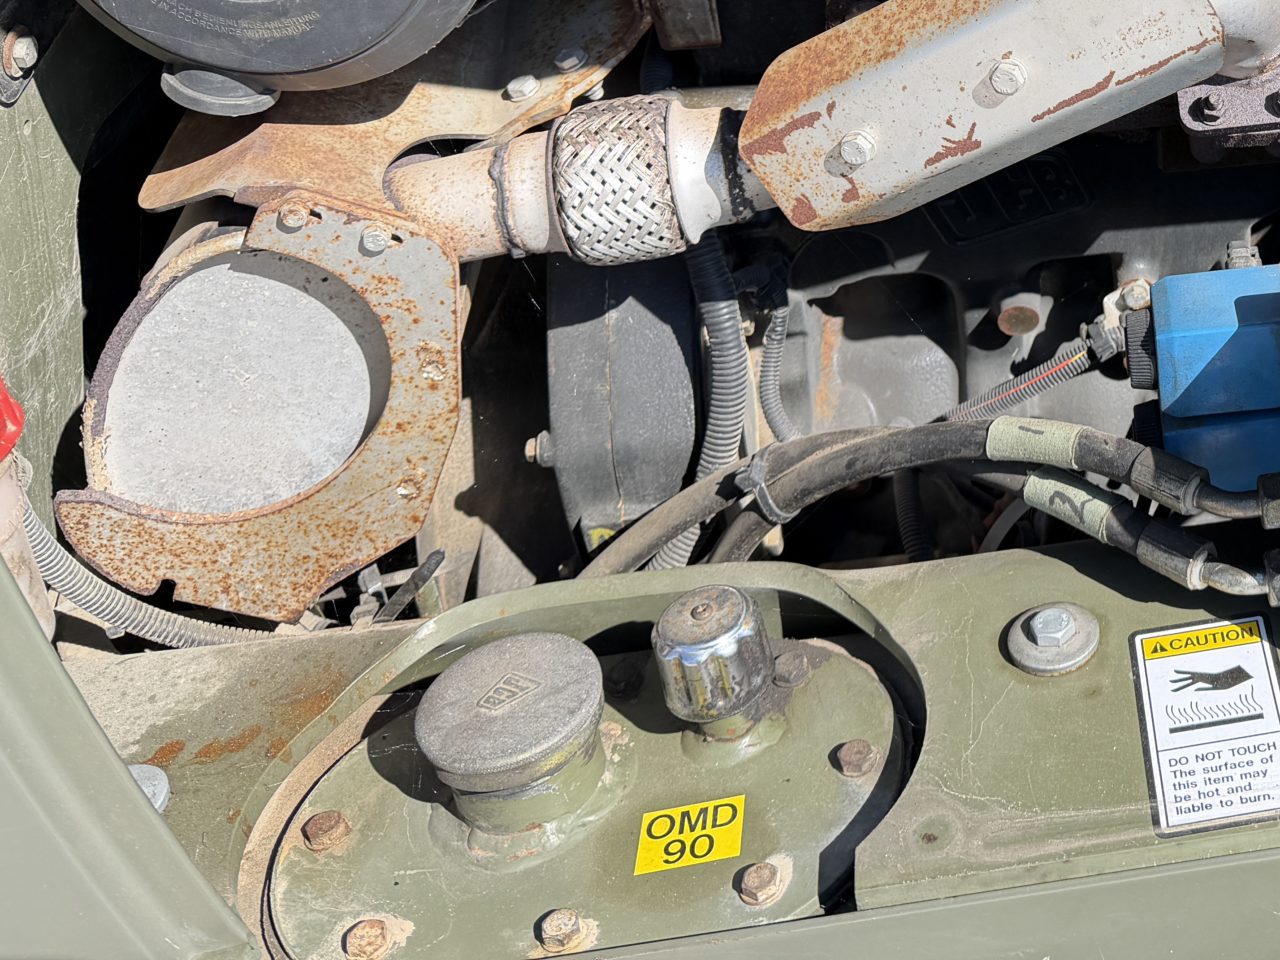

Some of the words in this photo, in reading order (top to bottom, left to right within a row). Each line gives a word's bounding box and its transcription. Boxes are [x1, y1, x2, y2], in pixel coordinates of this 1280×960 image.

[1169, 626, 1254, 650] CAUTION
[1168, 755, 1190, 768] DO
[1195, 750, 1224, 764] NOT
[1228, 741, 1277, 758] TOUCH
[1170, 768, 1196, 780] The
[1202, 760, 1255, 774] surface
[1261, 754, 1274, 764] of
[1172, 779, 1197, 791] this
[1203, 774, 1235, 787] item
[1239, 769, 1268, 782] may
[1174, 791, 1193, 804] be
[1197, 787, 1221, 798] hot
[1226, 782, 1252, 795] and
[1175, 801, 1213, 816] liable
[1218, 798, 1234, 808] to
[1239, 793, 1275, 805] burn.
[646, 803, 738, 840] OMD
[662, 833, 715, 865] 90
